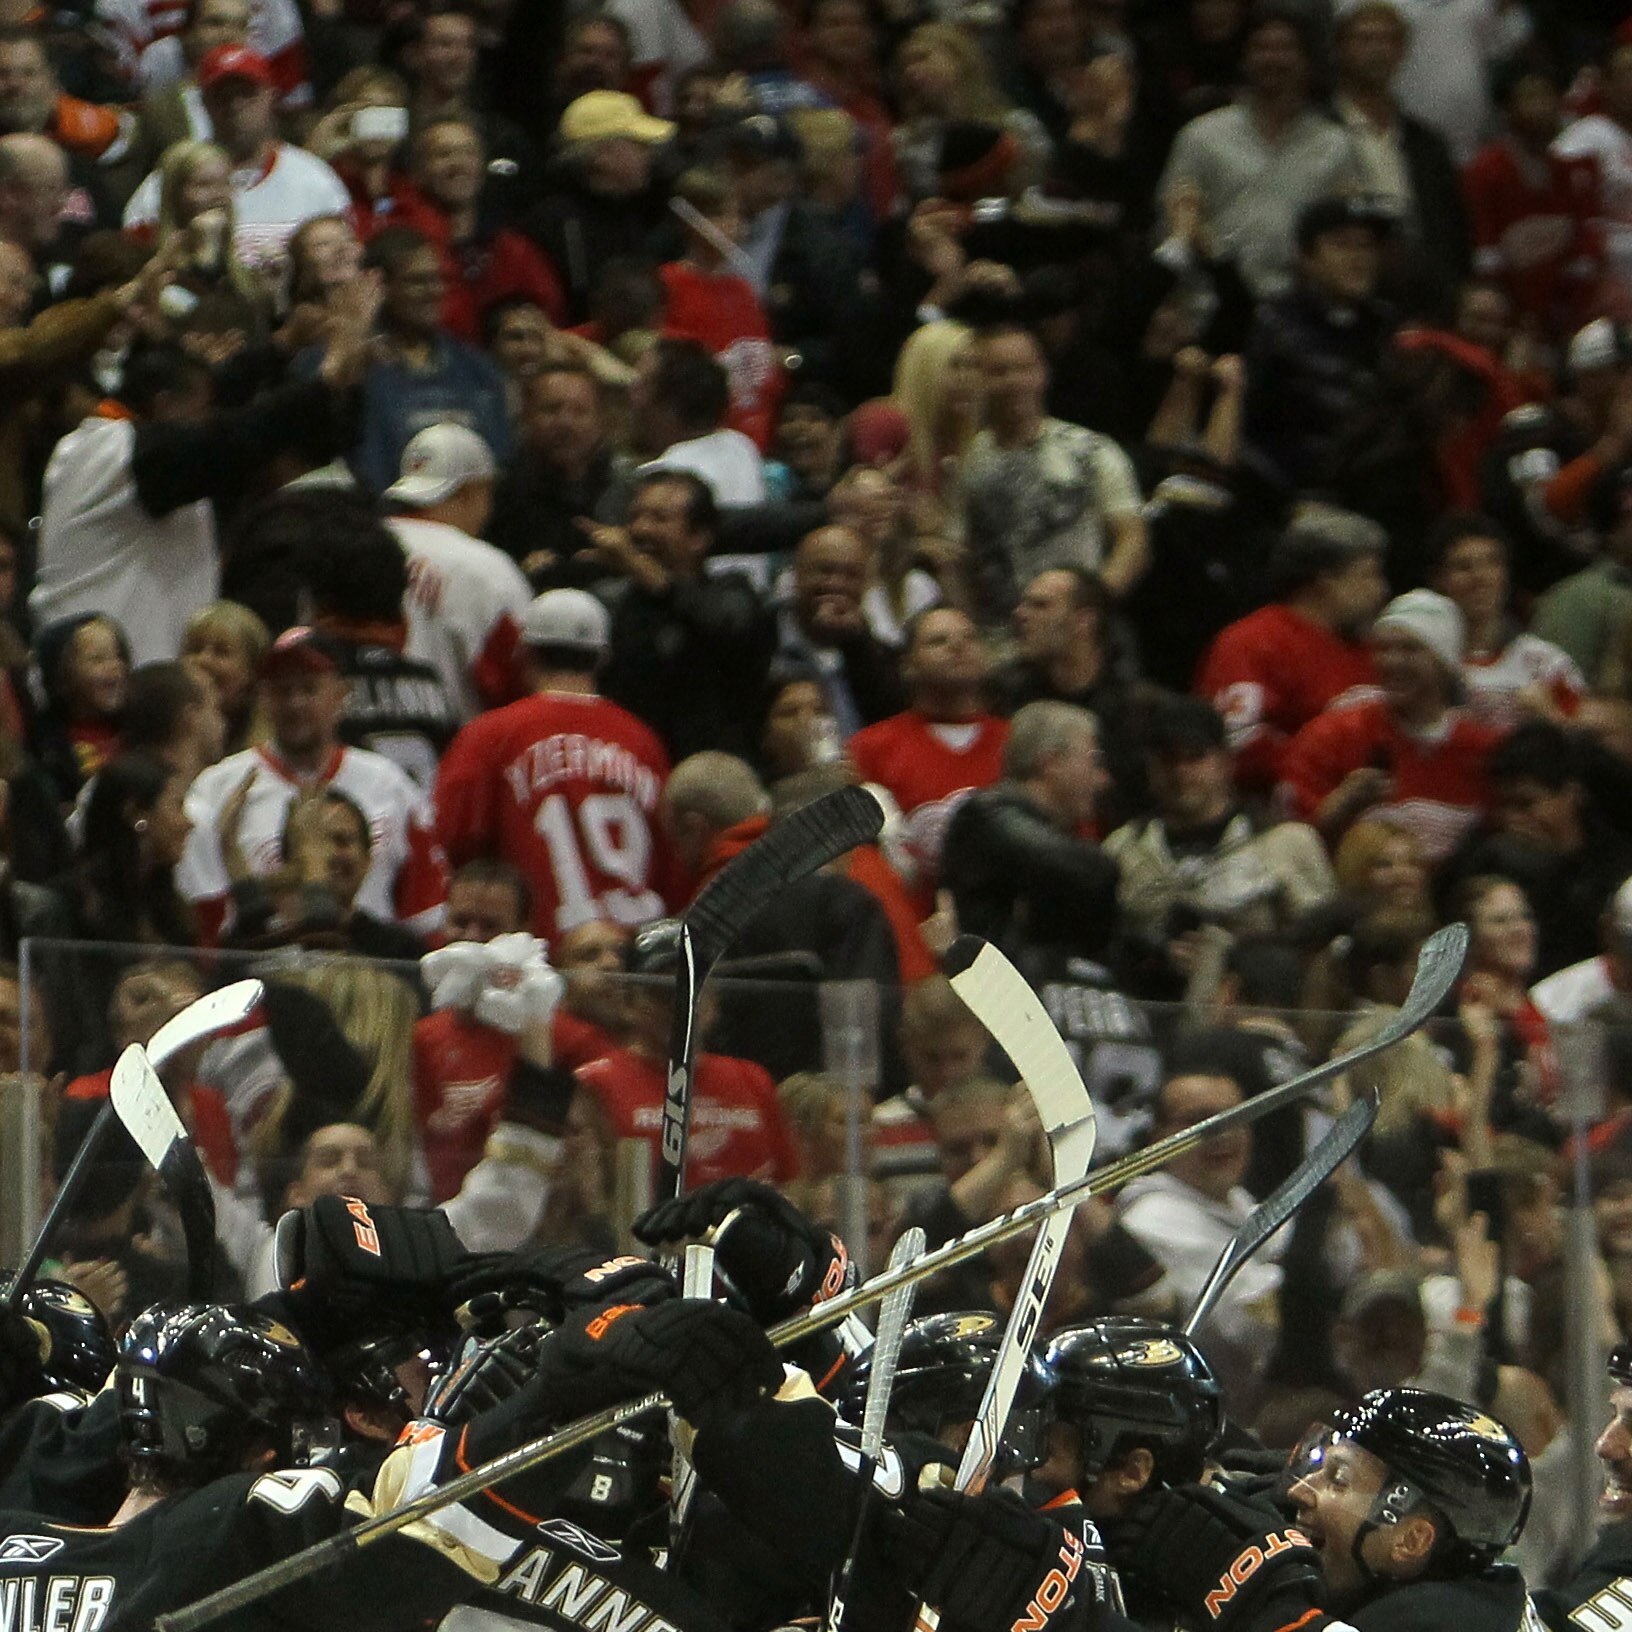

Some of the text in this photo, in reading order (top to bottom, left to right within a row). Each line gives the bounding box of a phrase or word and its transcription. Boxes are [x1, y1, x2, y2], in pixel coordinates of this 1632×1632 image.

[534, 795, 665, 932] 19
[132, 1377, 146, 1404] 4
[589, 1473, 613, 1502] 8
